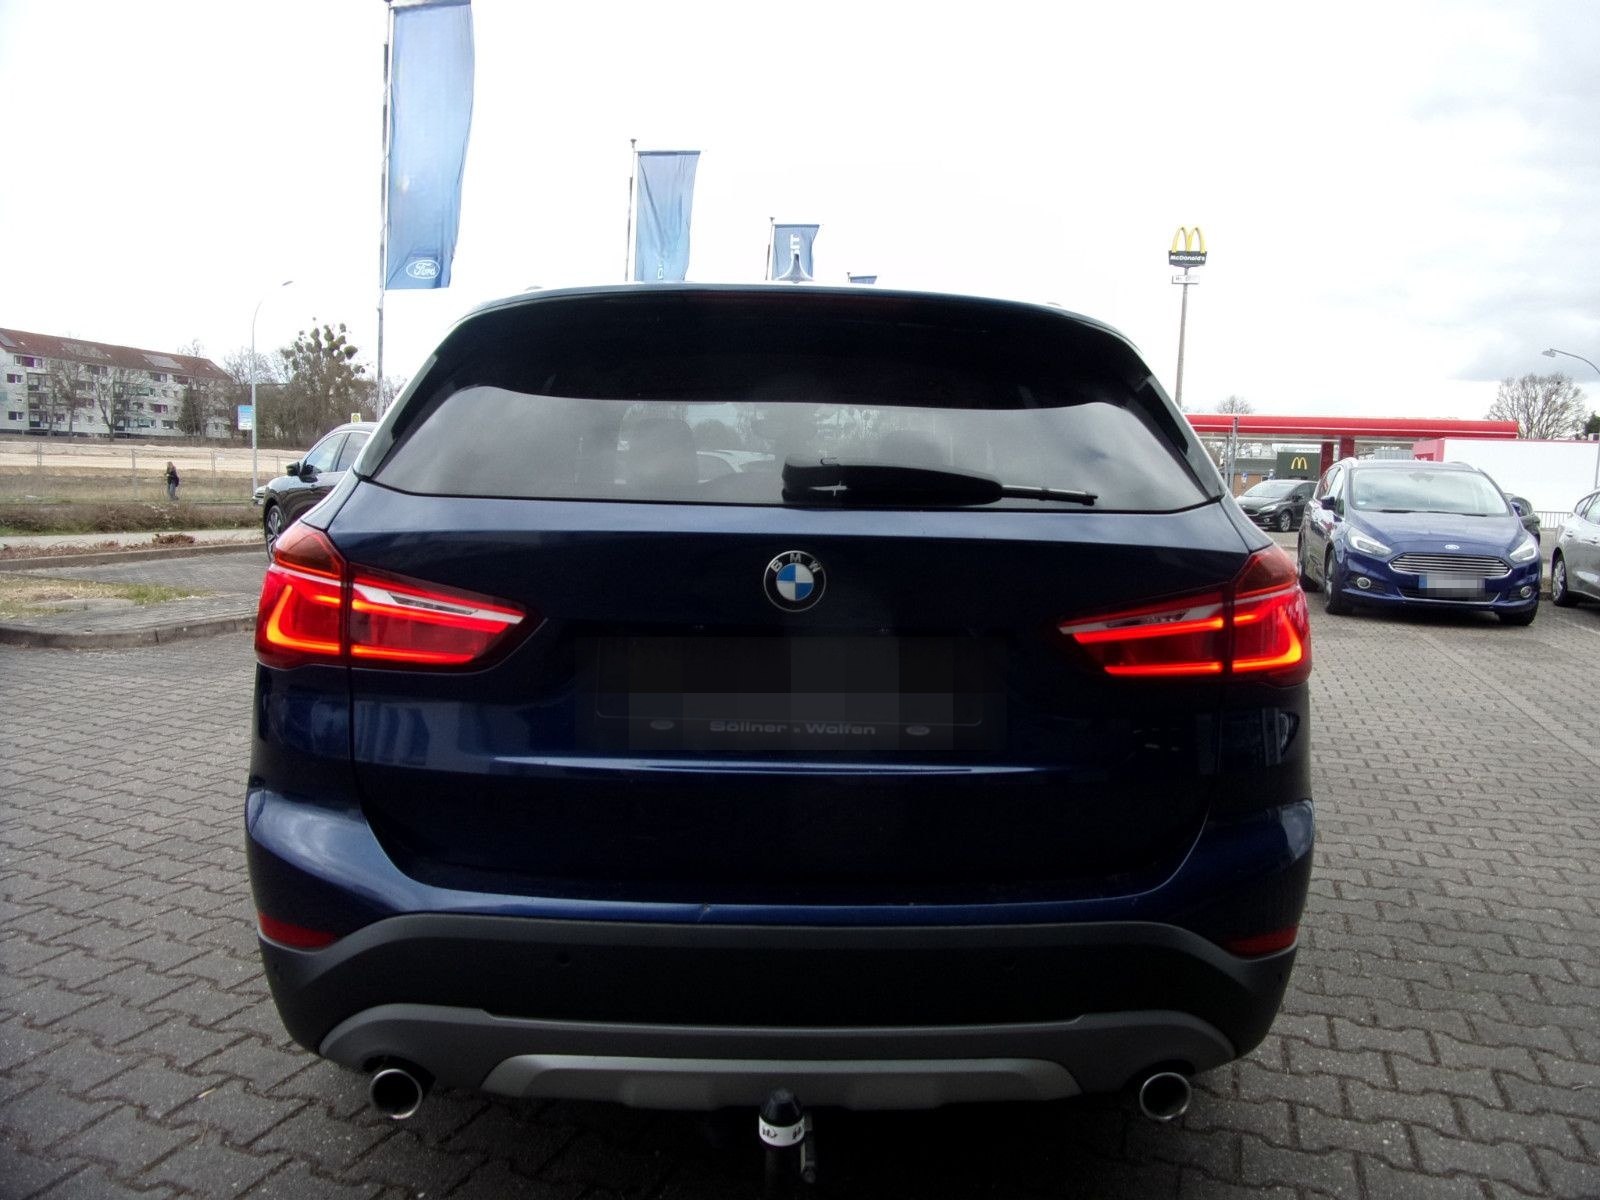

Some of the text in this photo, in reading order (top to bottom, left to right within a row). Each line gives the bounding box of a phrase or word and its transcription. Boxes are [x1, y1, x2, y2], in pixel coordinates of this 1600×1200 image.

[413, 261, 437, 277] Ford
[770, 552, 821, 573] BMW
[709, 720, 788, 733] Söllner
[805, 722, 876, 735] Wolfen
